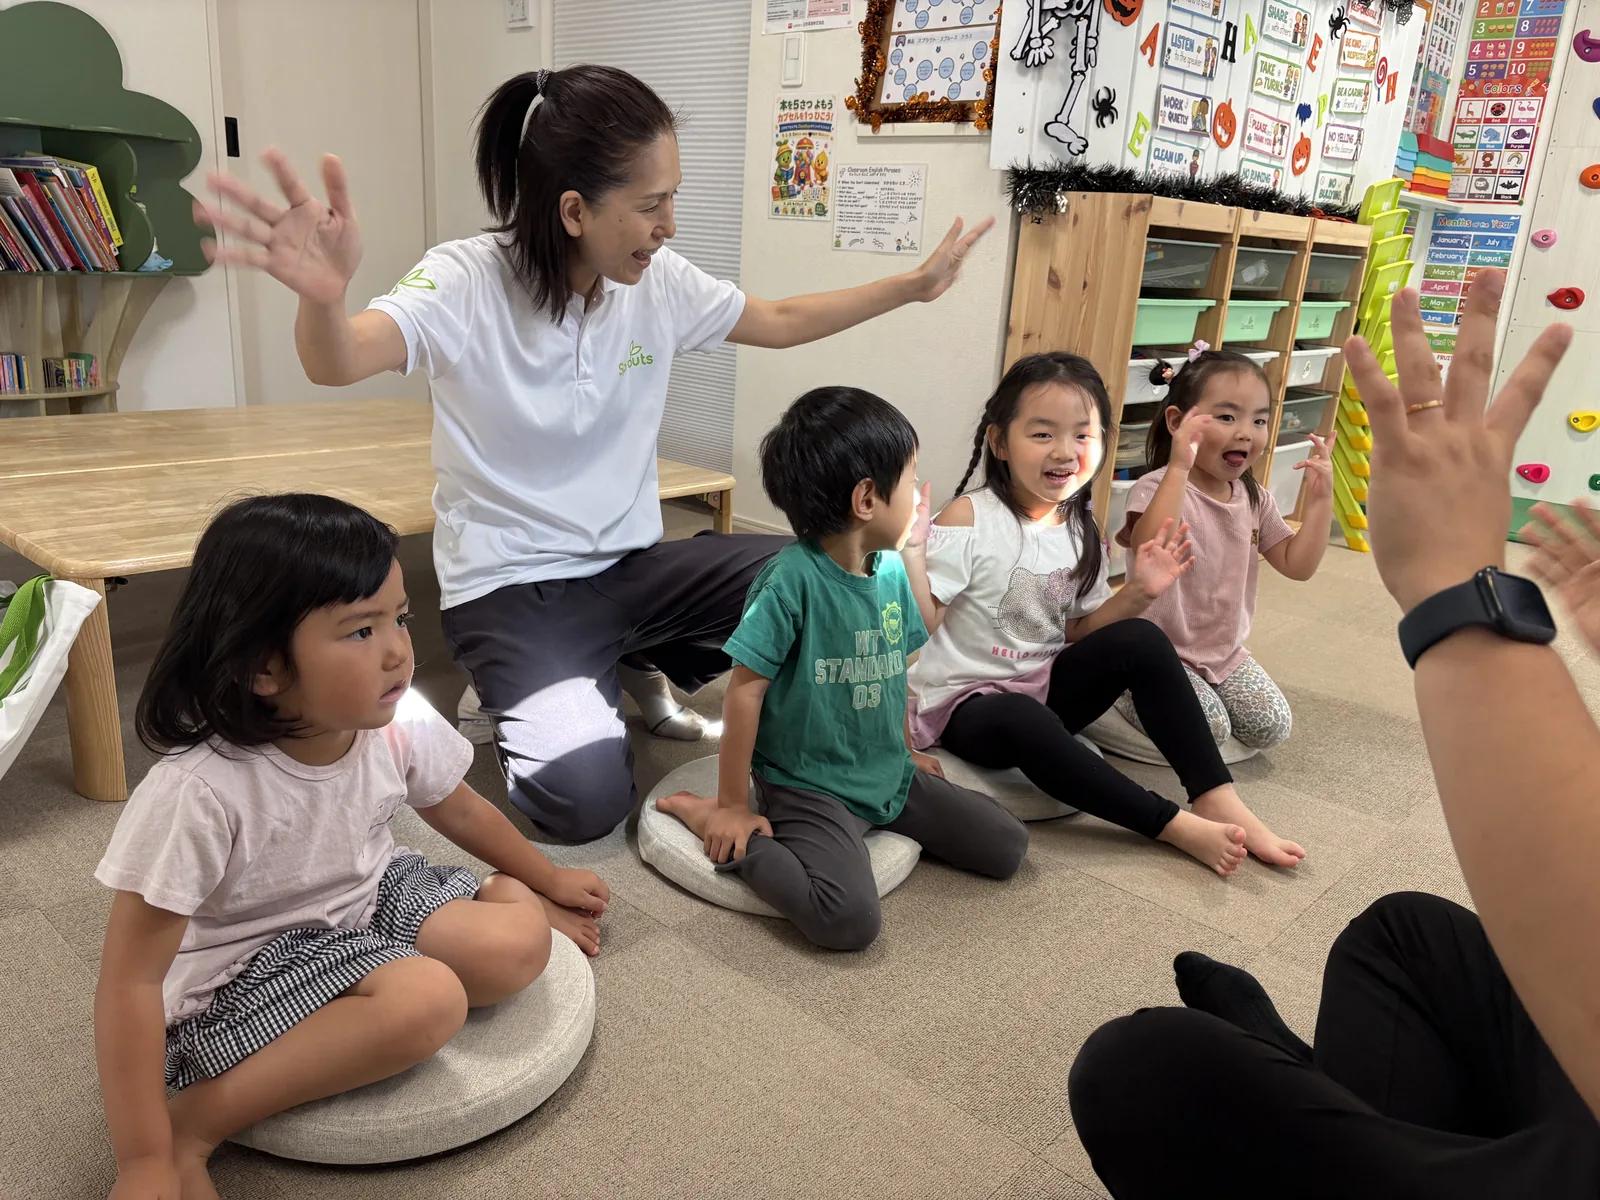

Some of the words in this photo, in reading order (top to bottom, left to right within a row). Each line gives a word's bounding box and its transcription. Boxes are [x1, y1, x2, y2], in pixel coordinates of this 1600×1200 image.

[1480, 2, 1490, 13] 2
[1526, 0, 1534, 11] 7
[1268, 5, 1288, 24] SHARE
[1476, 22, 1485, 34] 3
[1521, 20, 1530, 32] 8
[1243, 13, 1258, 54] A
[1171, 32, 1195, 52] LISTEN
[1221, 21, 1238, 63] H
[1516, 42, 1525, 54] 9
[1307, 32, 1323, 72] E
[1472, 43, 1481, 55] 4
[1260, 60, 1276, 76] TAKE
[1468, 64, 1477, 76] 5
[1510, 63, 1526, 74] 10
[1264, 76, 1283, 93] TURNS
[1385, 71, 1398, 104] H
[1483, 83, 1522, 94] Colors
[1337, 87, 1343, 96] BE
[780, 99, 812, 110] 本を5さつ
[815, 99, 833, 109] よもう
[1163, 95, 1184, 111] WORK
[1168, 111, 1189, 125] QUIETLY
[1317, 94, 1328, 129] P
[1252, 119, 1268, 134] PLEASE
[1128, 111, 1150, 158] E
[1254, 133, 1264, 144] THANK
[1264, 138, 1272, 146] YOU
[1328, 131, 1336, 142] NO
[1337, 132, 1354, 144] YELLING
[1153, 147, 1173, 164] CLEAN
[1174, 152, 1184, 164] UP
[1242, 168, 1250, 179] NO
[1328, 178, 1337, 189] NO
[1438, 217, 1472, 227] Months
[1491, 219, 1514, 229] Year
[1437, 237, 1465, 245] January
[1431, 252, 1464, 260] February
[1477, 255, 1501, 263] August
[618, 353, 654, 376] Souts
[992, 646, 1030, 659] HELLO
[815, 650, 903, 684] STANDARD
[852, 683, 881, 710] 03
